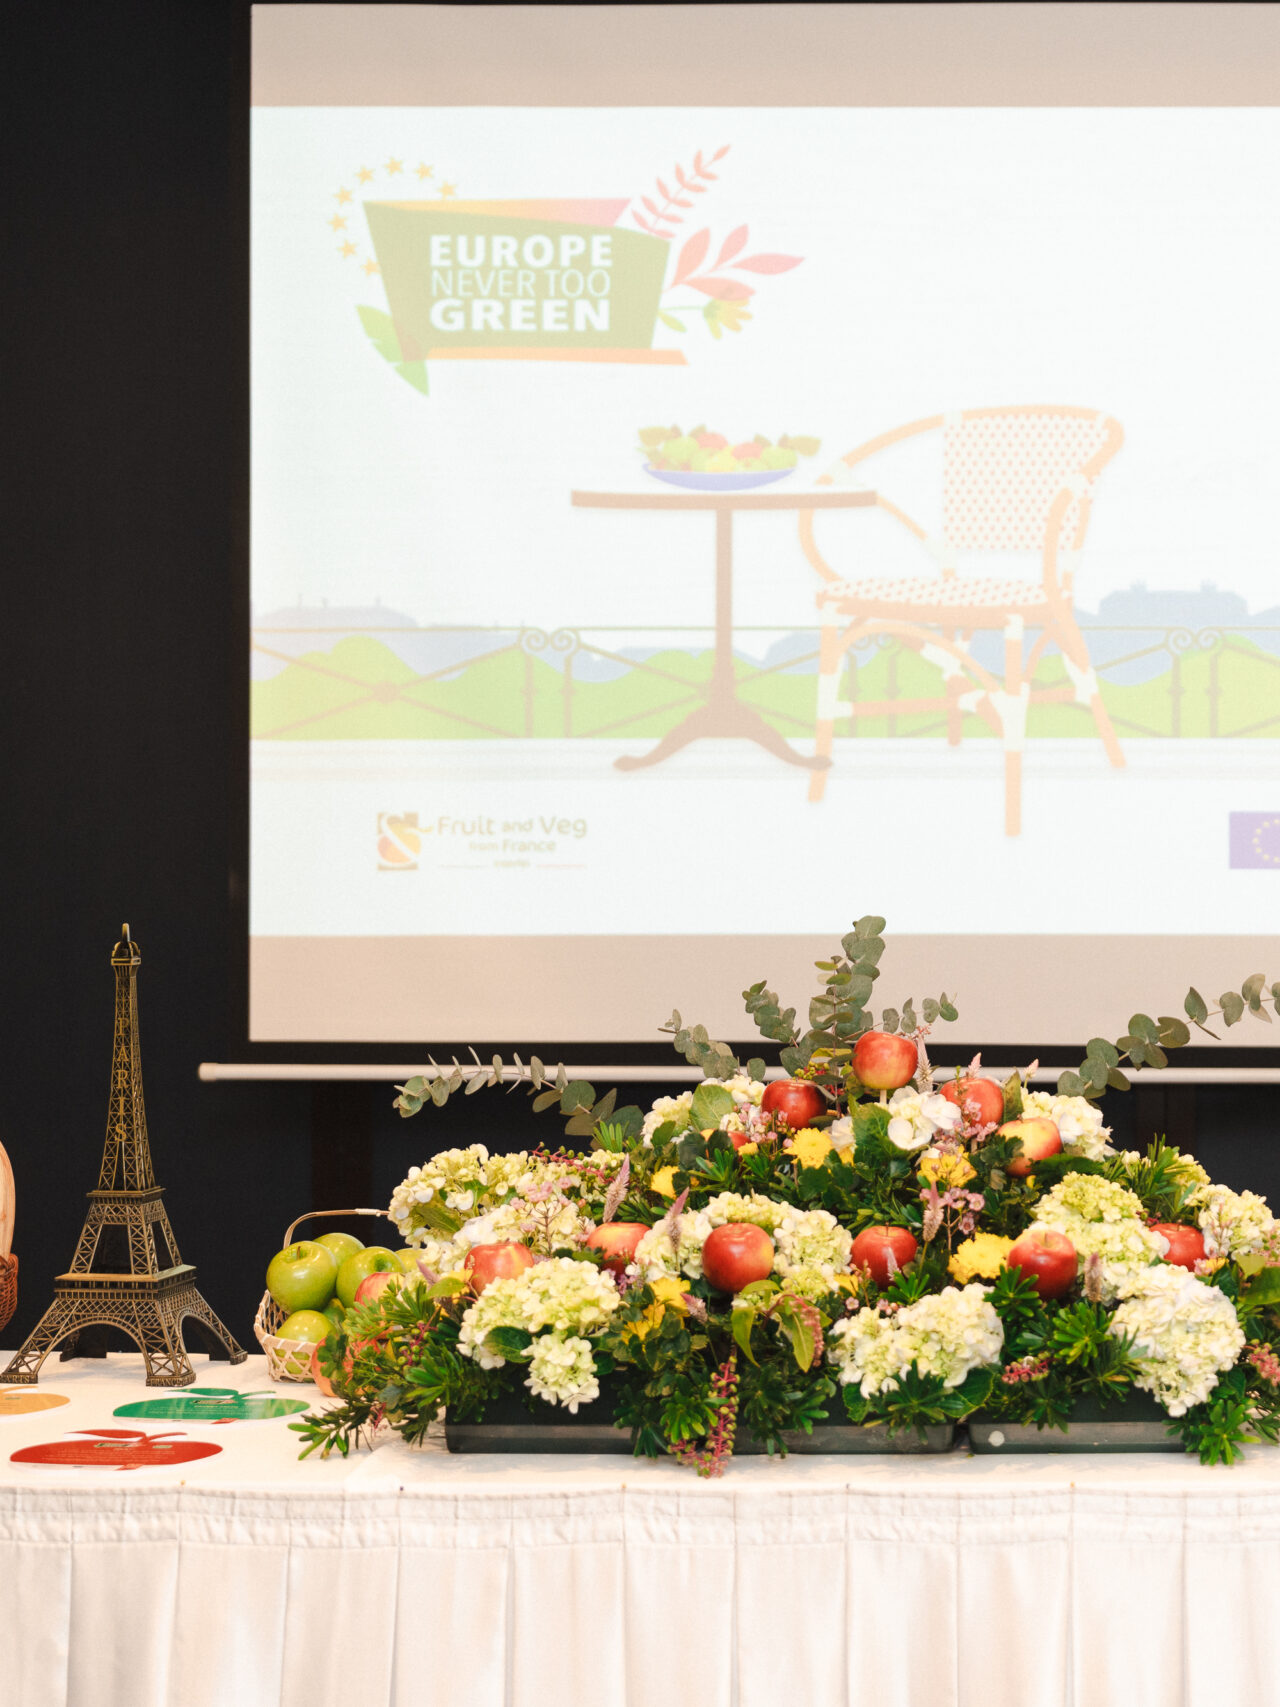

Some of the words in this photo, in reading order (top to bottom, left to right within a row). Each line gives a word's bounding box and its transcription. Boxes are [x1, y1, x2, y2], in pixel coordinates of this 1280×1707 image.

[430, 234, 613, 268] EUROPE
[431, 269, 536, 297] NEVER
[541, 269, 611, 297] TOO
[429, 298, 611, 332] GREEN
[437, 816, 496, 836] Fruit
[500, 819, 534, 834] and
[539, 816, 588, 839] Veg
[502, 839, 557, 853] France
